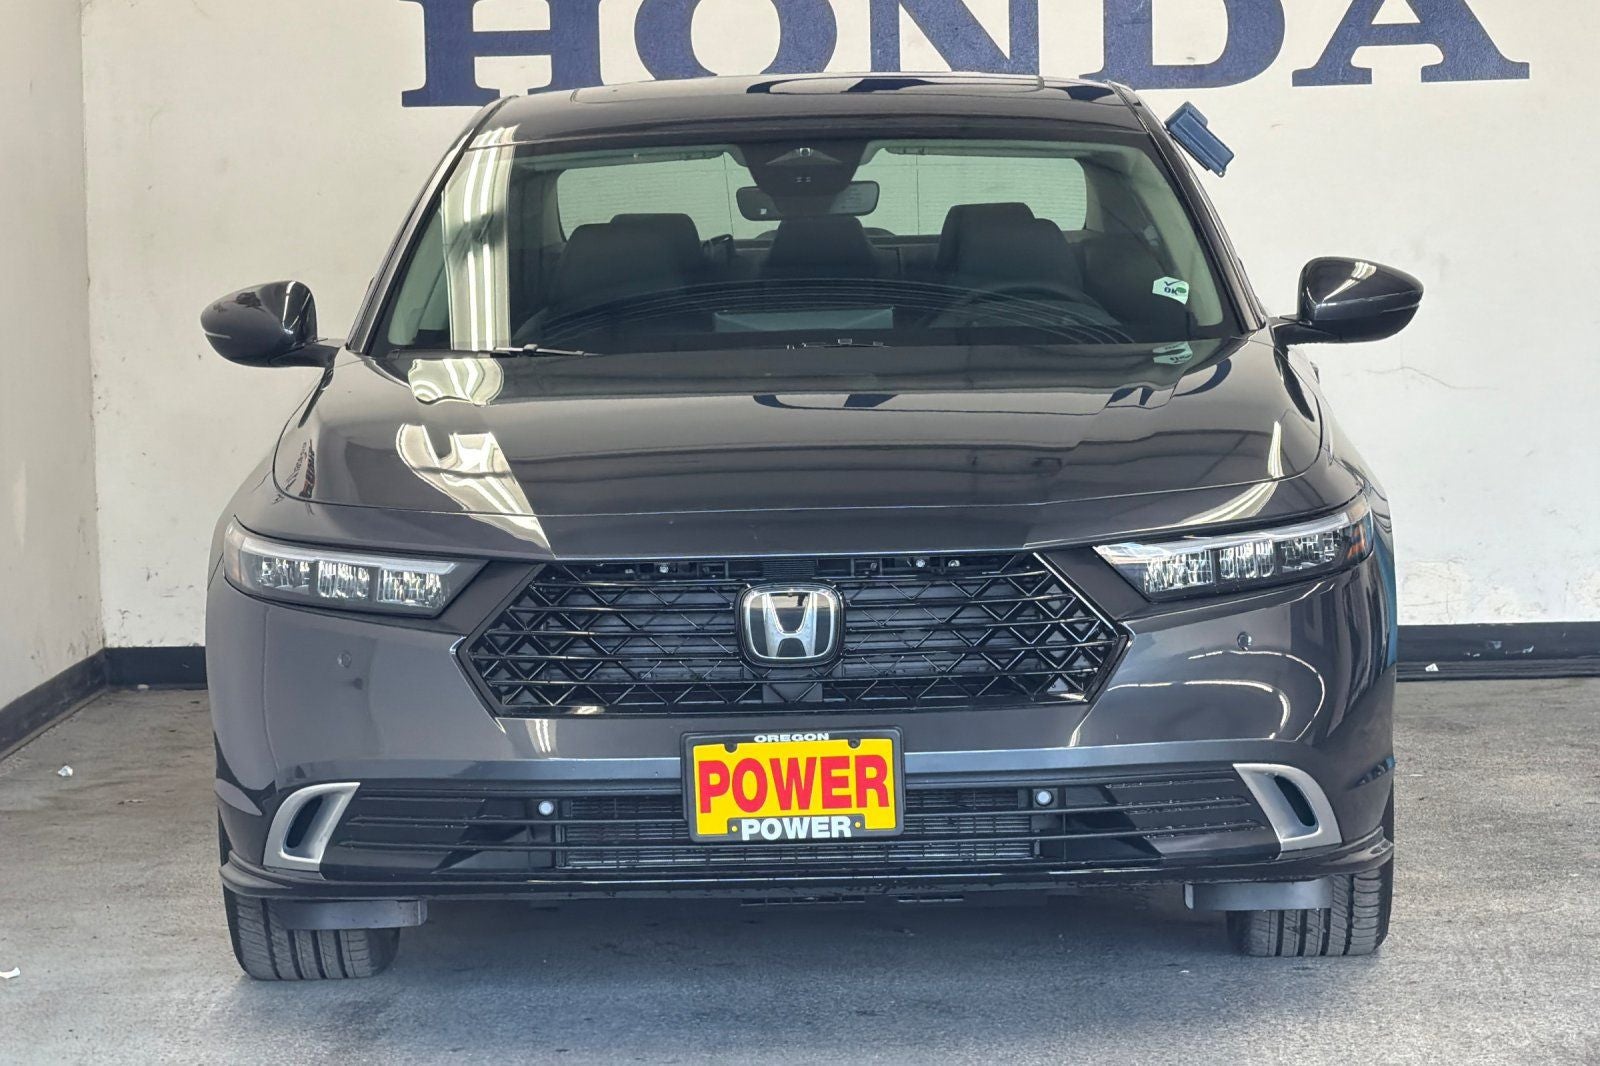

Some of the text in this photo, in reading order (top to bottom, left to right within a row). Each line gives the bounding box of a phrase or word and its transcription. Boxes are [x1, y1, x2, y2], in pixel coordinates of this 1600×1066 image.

[402, 0, 1529, 107] HONDA
[754, 733, 830, 743] OREGON
[698, 755, 889, 813] POWER
[741, 816, 852, 841] POWER
